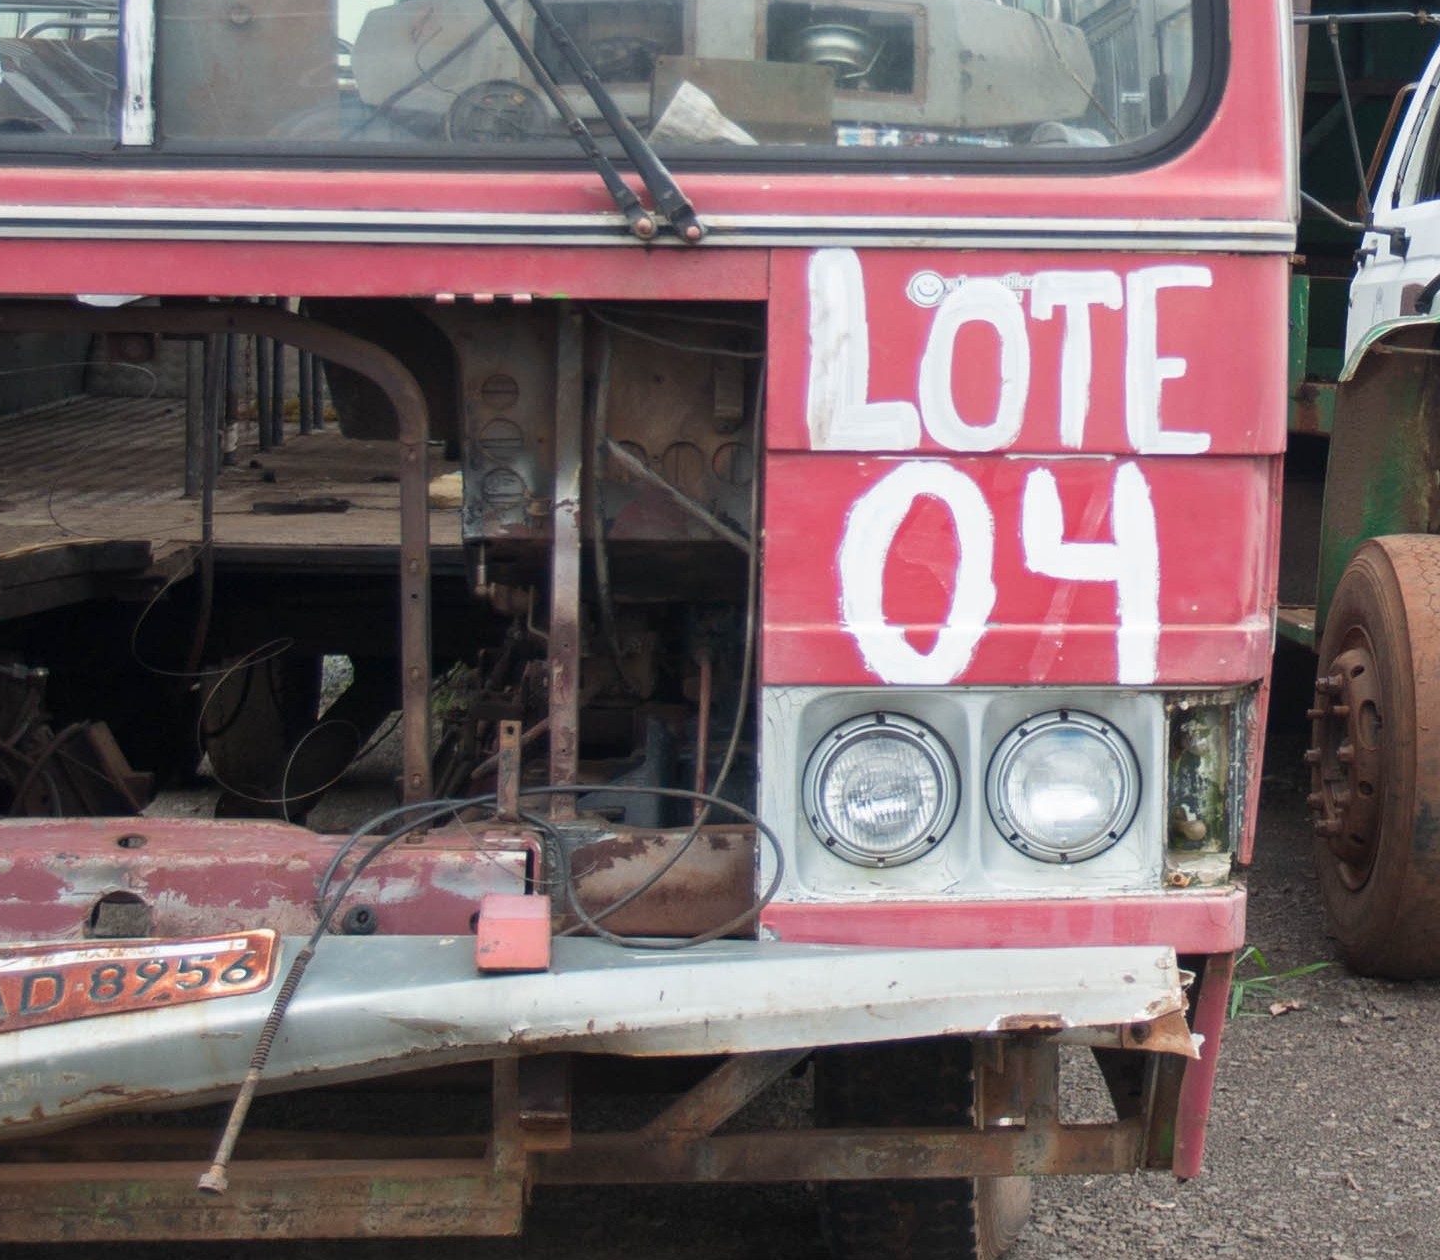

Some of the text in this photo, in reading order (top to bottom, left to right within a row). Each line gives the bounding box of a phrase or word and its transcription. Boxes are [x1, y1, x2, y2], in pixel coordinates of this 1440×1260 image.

[807, 246, 1213, 455] LOTE
[838, 460, 1159, 685] 04
[87, 951, 257, 1002] 8956
